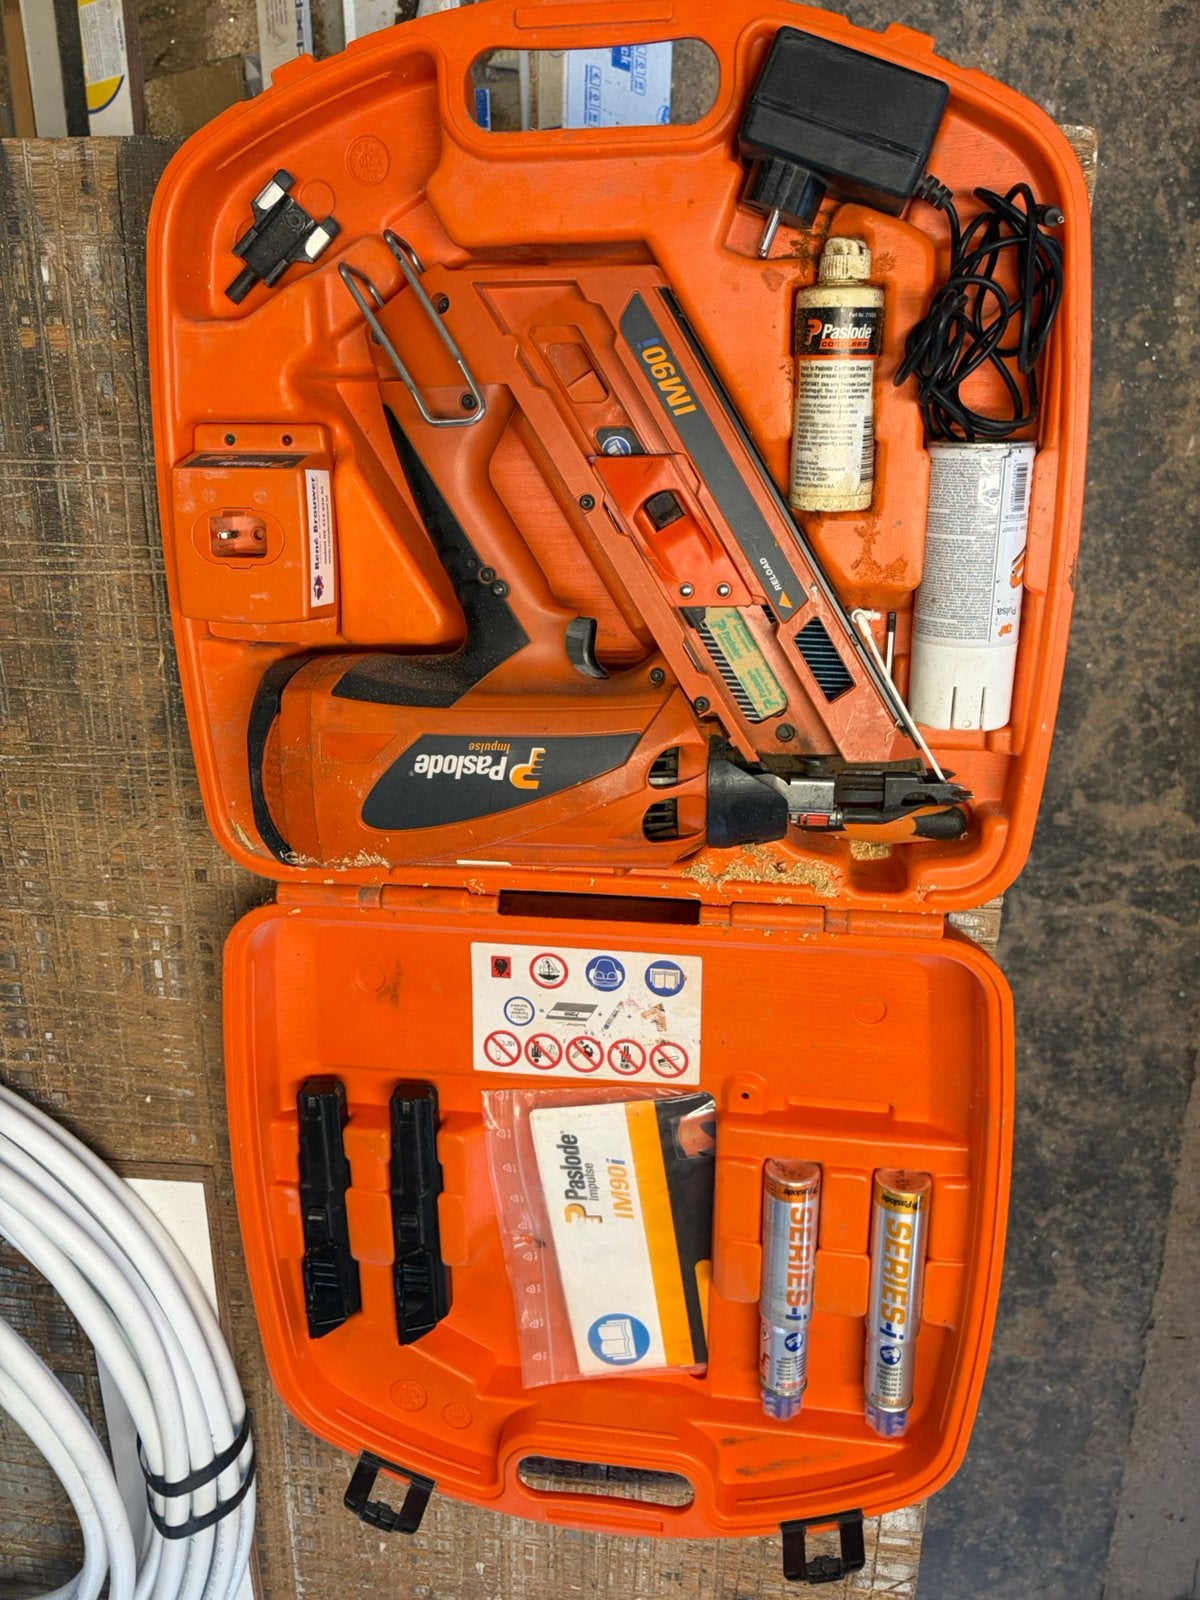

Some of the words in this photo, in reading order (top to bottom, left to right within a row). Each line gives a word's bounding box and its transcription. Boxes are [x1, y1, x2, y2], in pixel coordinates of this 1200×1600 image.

[822, 324, 872, 339] Paslode
[637, 337, 698, 416] IM90i
[310, 476, 319, 533] Brouwer
[759, 557, 783, 591] RELOAD
[468, 741, 511, 754] Impulse
[413, 753, 508, 781] Paslode
[556, 1134, 588, 1201] Paslode
[584, 1162, 600, 1202] Impulse
[606, 1158, 635, 1220] IM90i
[882, 1194, 912, 1208] Paslode
